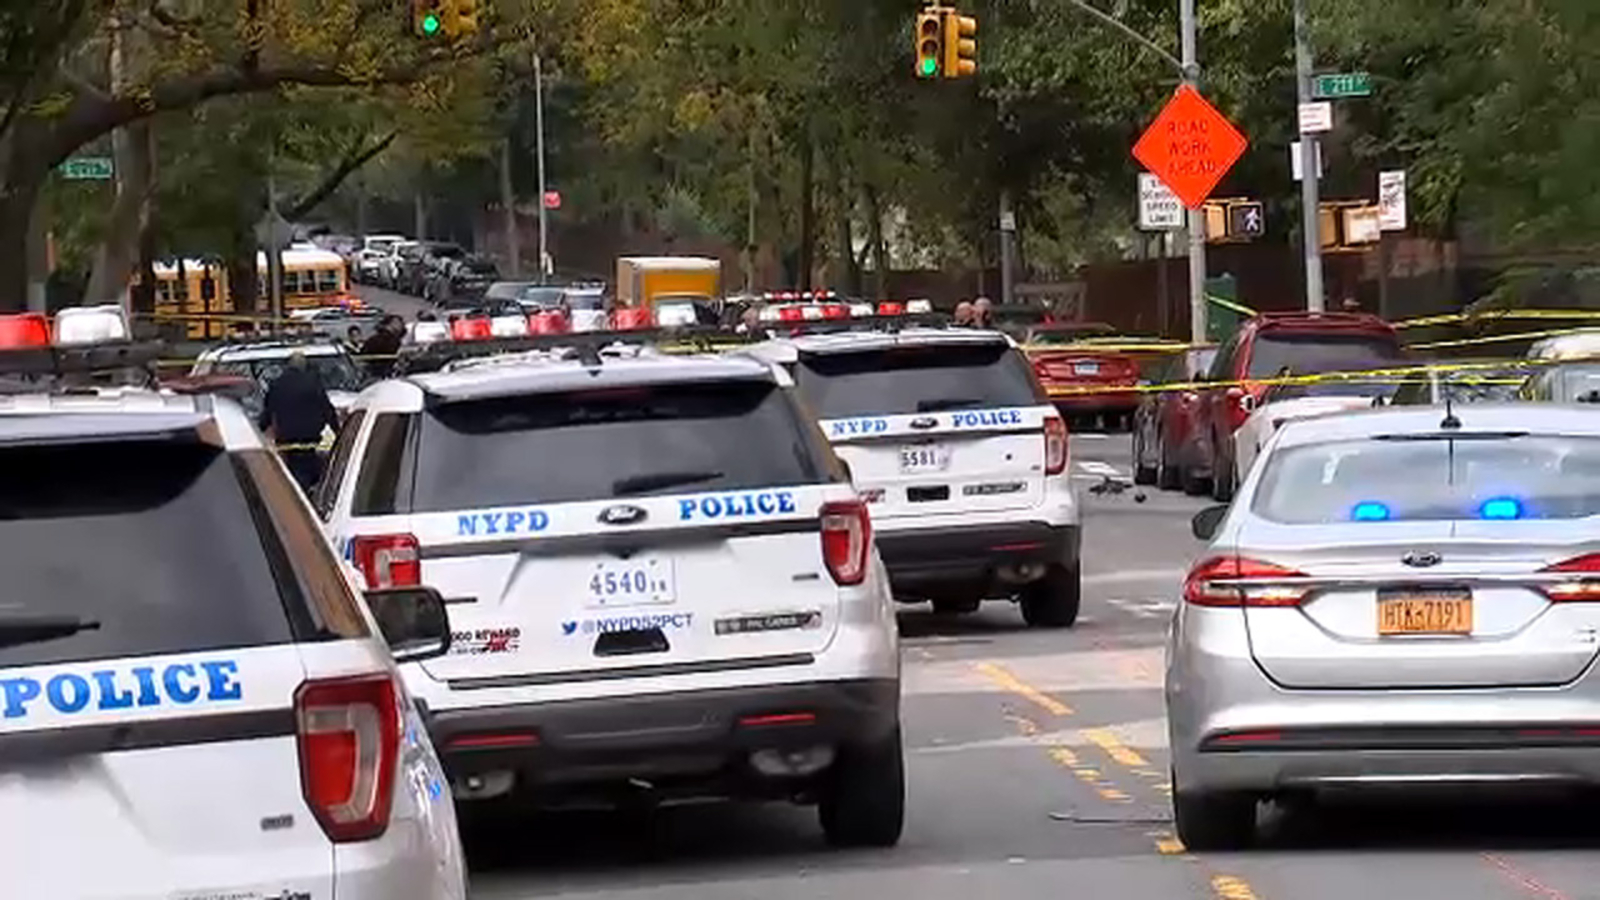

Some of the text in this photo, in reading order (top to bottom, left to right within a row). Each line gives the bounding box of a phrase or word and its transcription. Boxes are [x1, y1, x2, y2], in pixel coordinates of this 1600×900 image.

[1167, 120, 1208, 136] ROAD
[1169, 140, 1212, 155] WORK
[1169, 160, 1216, 176] AHEAD
[1146, 202, 1178, 212] SPEED
[1149, 213, 1175, 223] LIMIT
[832, 419, 888, 436] NYPD
[952, 410, 1022, 428] POLICE
[457, 510, 549, 535] NYPD
[678, 492, 795, 520] POLICE
[590, 570, 646, 595] 4540
[0, 660, 242, 718] POLICE
